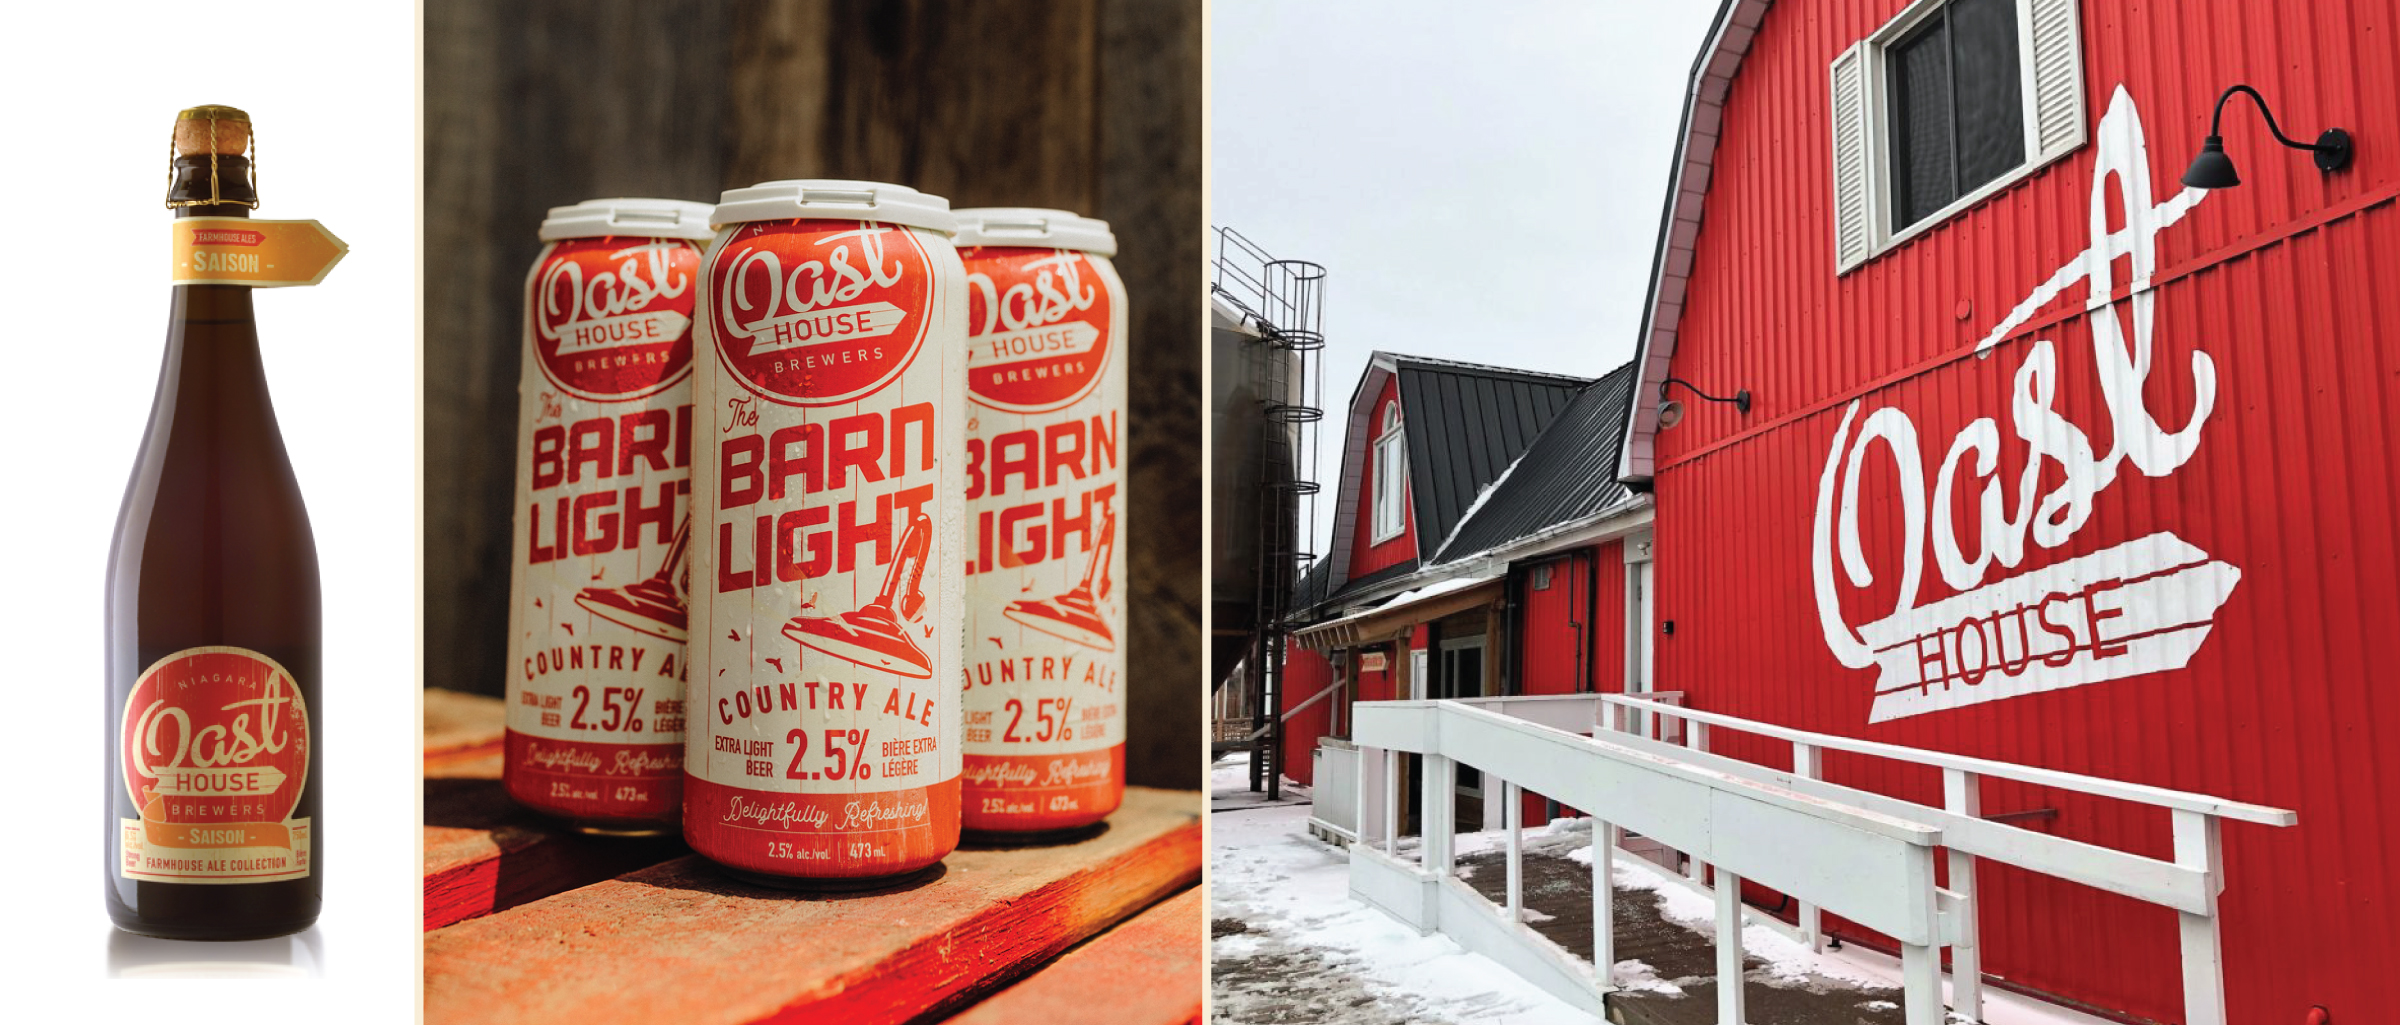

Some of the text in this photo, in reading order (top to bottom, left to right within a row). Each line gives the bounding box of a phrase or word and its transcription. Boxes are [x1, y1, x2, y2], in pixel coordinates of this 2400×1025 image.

[199, 231, 257, 244] FARMHOUSE ALES
[193, 251, 259, 273] SAISON
[538, 238, 687, 341] Oast
[722, 220, 903, 339] Oast
[576, 318, 660, 346] HOUSE
[774, 310, 874, 345] HOUSE
[992, 329, 1076, 358] HOUSE
[574, 350, 670, 373] BREWERS
[774, 347, 884, 373] BREWERS
[993, 360, 1085, 385] BREWERS
[1812, 83, 2216, 668] Oast
[722, 396, 760, 434] The
[720, 401, 935, 509] BARN
[718, 483, 934, 594] LIGHT
[1915, 576, 2129, 696] HOUSE
[524, 645, 646, 682] COUNTRY
[963, 656, 1117, 694] OUNTRY ALE
[178, 673, 257, 690] NIAGARA
[570, 685, 645, 733] 2.5%
[718, 681, 936, 728] COUNTRY ALE
[132, 668, 290, 779] Oast
[653, 715, 686, 733] LÉGÈR
[964, 710, 992, 726] LIGHT
[1003, 697, 1073, 743] 2.5%
[715, 734, 774, 758] EXTRA LIGHT
[882, 735, 937, 758] BIÈRE EXTRA
[966, 728, 992, 743] BEER
[786, 728, 872, 781] 2.5%
[746, 760, 774, 779] BEER
[882, 758, 919, 779] LÉGÈRE
[176, 772, 260, 792] HOUSE
[615, 786, 636, 802] 473
[172, 803, 265, 817] BREWERS
[723, 795, 829, 830] Delightfully
[189, 828, 246, 845] SAISON
[768, 842, 793, 860] 2.5%
[850, 842, 872, 860] 473
[146, 856, 204, 872] FARMHOUSE
[206, 858, 227, 872] ALE
[230, 856, 287, 872] COLLECTION
